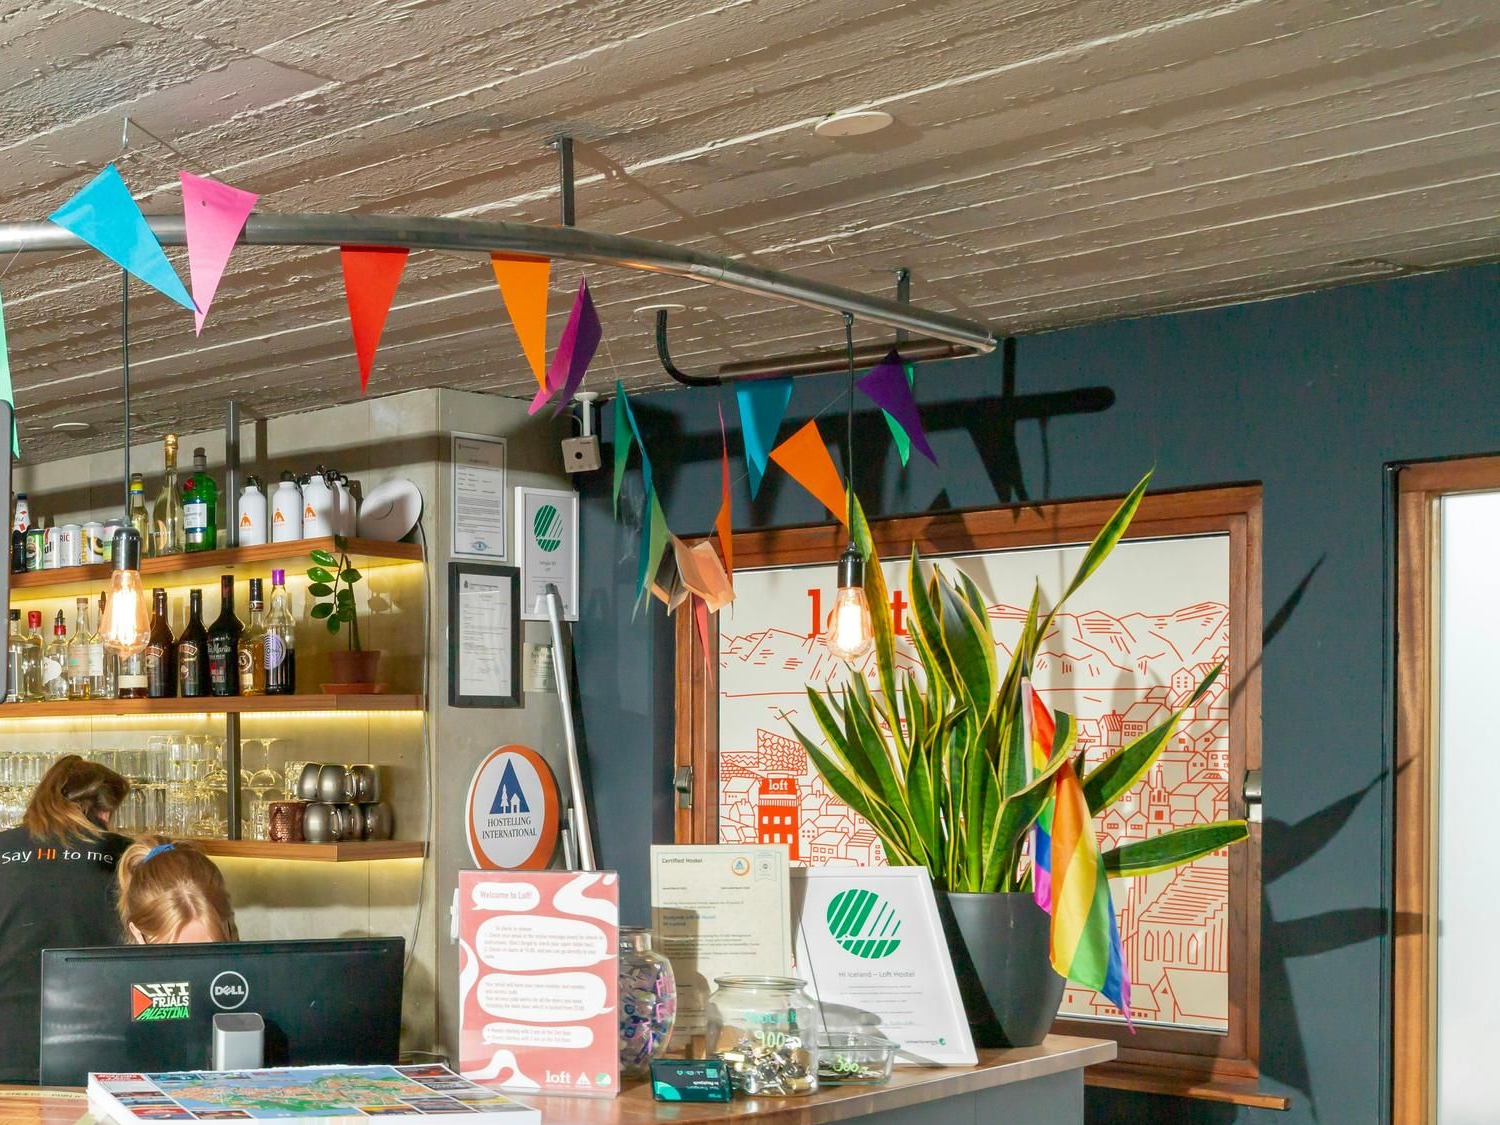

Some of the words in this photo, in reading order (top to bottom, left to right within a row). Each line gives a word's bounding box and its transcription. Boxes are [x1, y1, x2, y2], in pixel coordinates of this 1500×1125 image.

[807, 588, 908, 639] lt
[768, 779, 788, 791] loft
[487, 816, 532, 827] HOSTELLING
[482, 828, 537, 839] INTERNATIONAL
[1, 850, 32, 864] say
[37, 848, 57, 860] HI
[63, 849, 81, 860] to
[87, 851, 114, 864] me
[480, 890, 509, 899] Welcome
[133, 982, 189, 998] LIFI
[214, 985, 245, 996] DELL
[152, 994, 190, 1008] FRJÁLS
[545, 1070, 572, 1084] loft
